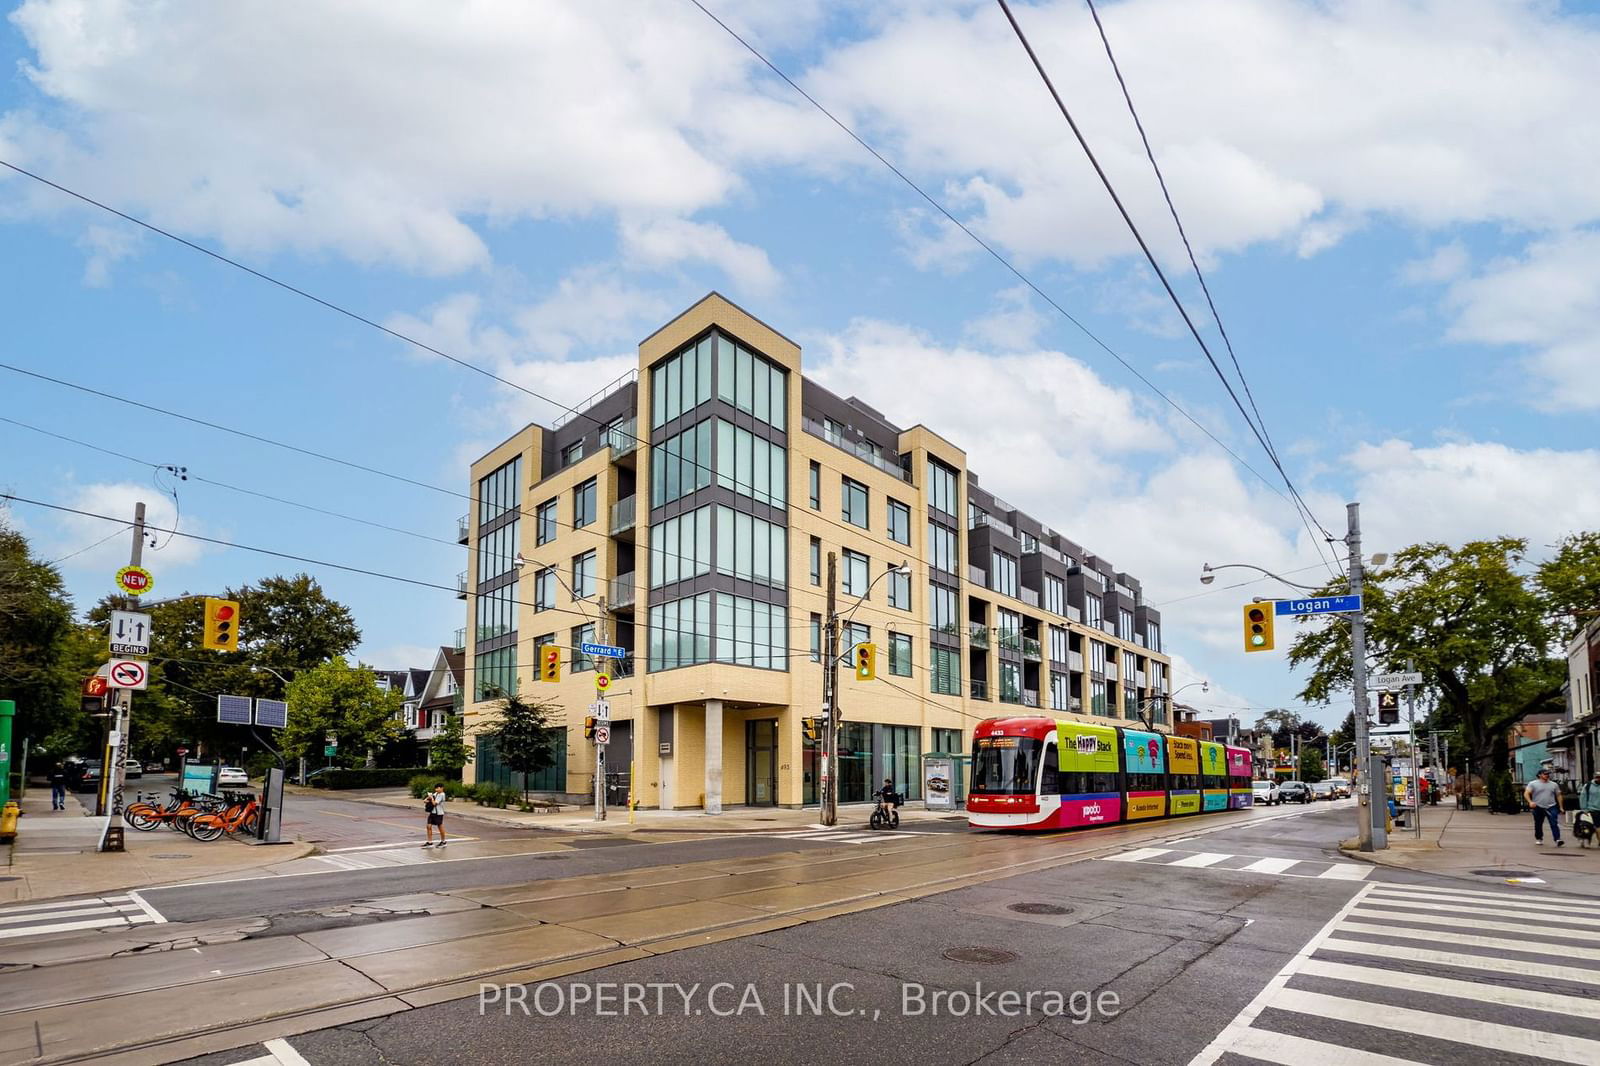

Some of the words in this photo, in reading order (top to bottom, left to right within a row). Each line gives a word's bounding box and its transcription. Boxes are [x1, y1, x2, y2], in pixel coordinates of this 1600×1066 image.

[123, 574, 146, 586] NEW
[1290, 600, 1330, 613] Logan
[113, 644, 145, 654] BEGINS
[584, 644, 611, 656] Gerrard
[1377, 676, 1400, 684] Logan
[1402, 674, 1416, 682] Ave
[1065, 736, 1077, 750] The
[1097, 740, 1112, 752] Stack
